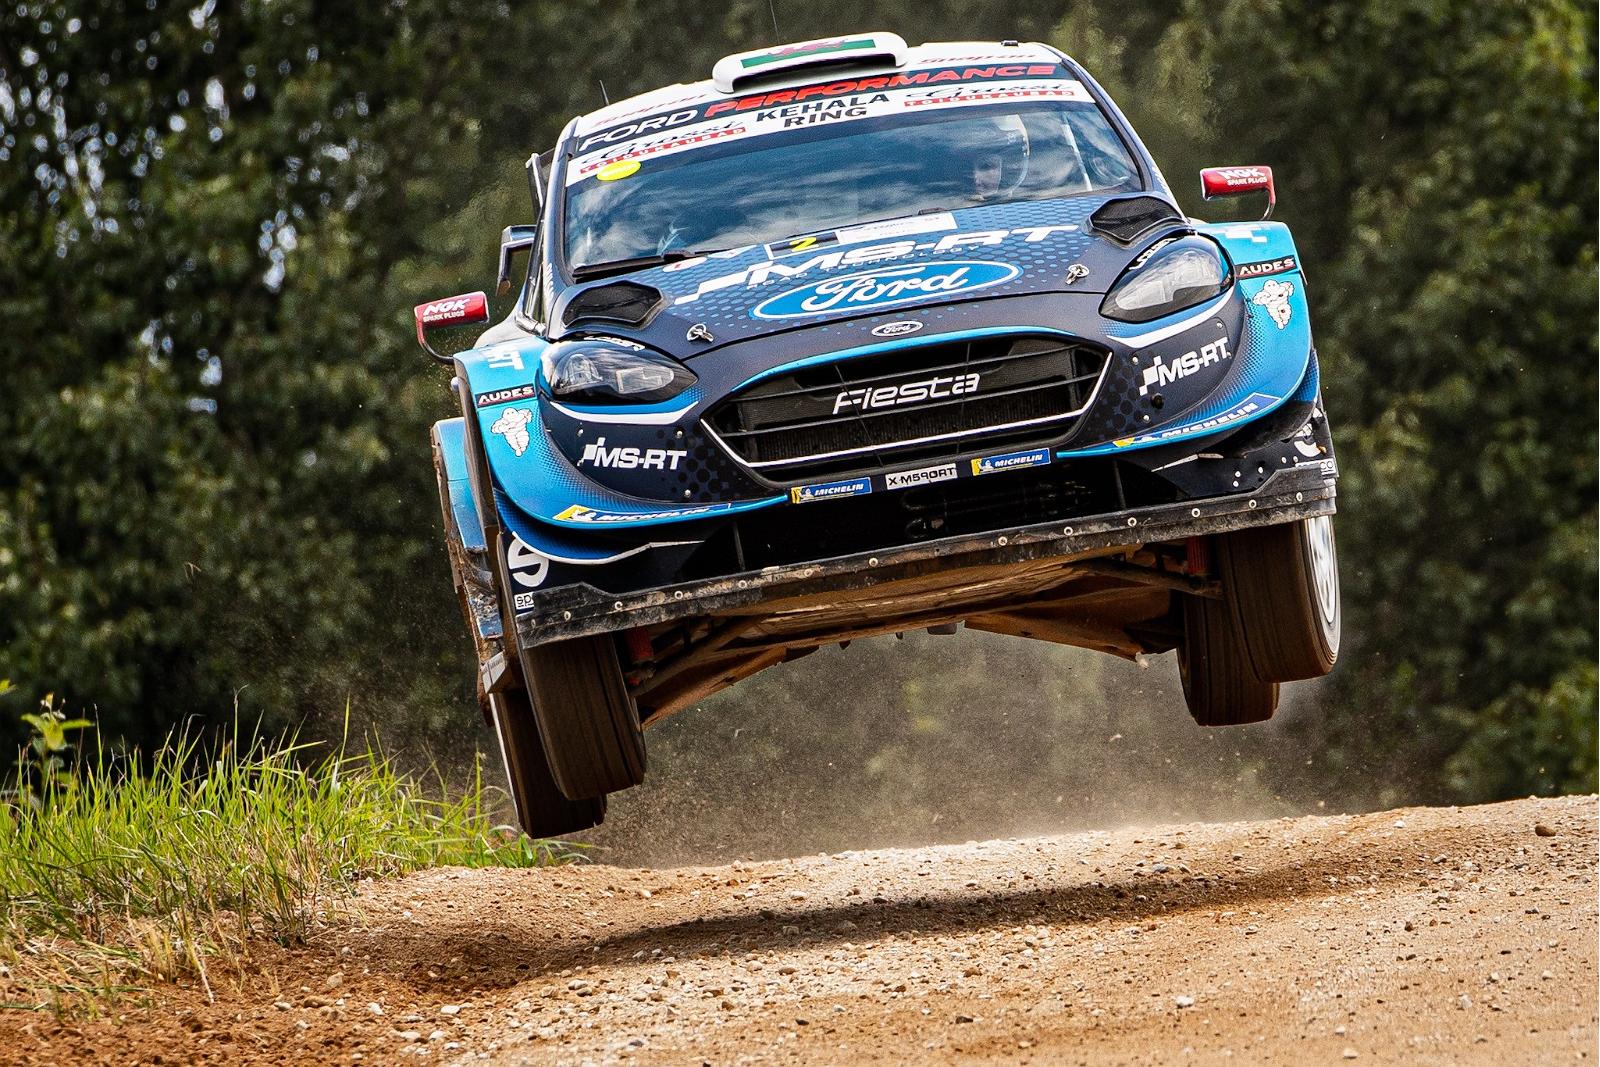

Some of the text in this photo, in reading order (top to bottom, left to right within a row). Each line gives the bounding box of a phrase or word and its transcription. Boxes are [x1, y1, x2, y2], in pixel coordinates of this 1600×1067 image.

[578, 108, 699, 152] FORD
[703, 64, 1056, 118] PERFORMANCE
[756, 94, 890, 122] KEHALA
[783, 108, 867, 127] RING
[1216, 168, 1266, 180] NGK
[789, 236, 819, 252] 2
[1239, 257, 1296, 277] AUDES
[800, 265, 968, 312] Ford
[422, 298, 470, 316] NGK
[478, 386, 534, 406] AUDES
[832, 373, 980, 415] Fiesta
[994, 453, 1043, 467] MICHELIN
[814, 482, 864, 497] MICHELIN
